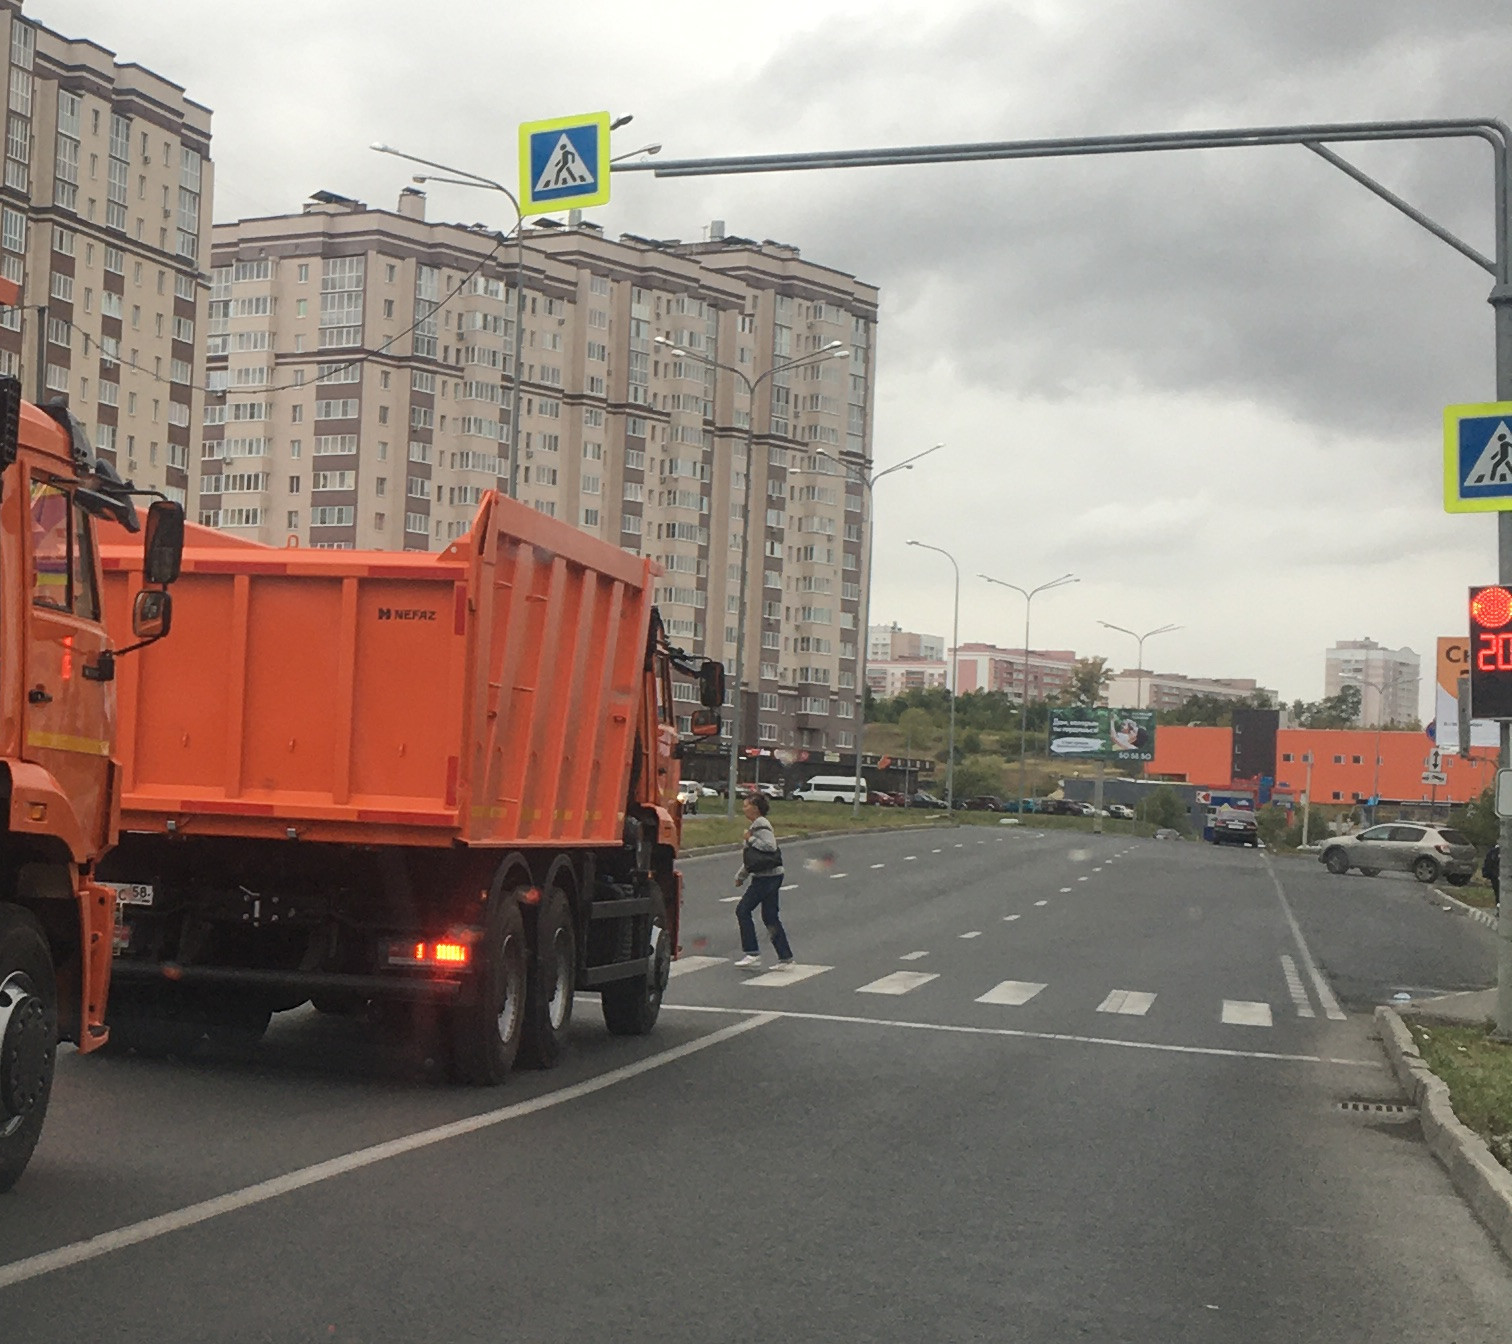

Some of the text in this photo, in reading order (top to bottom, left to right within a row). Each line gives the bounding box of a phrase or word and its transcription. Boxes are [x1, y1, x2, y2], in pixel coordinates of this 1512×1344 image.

[394, 609, 437, 621] NEFAZ
[1478, 633, 1512, 670] 20
[132, 886, 147, 898] 58
